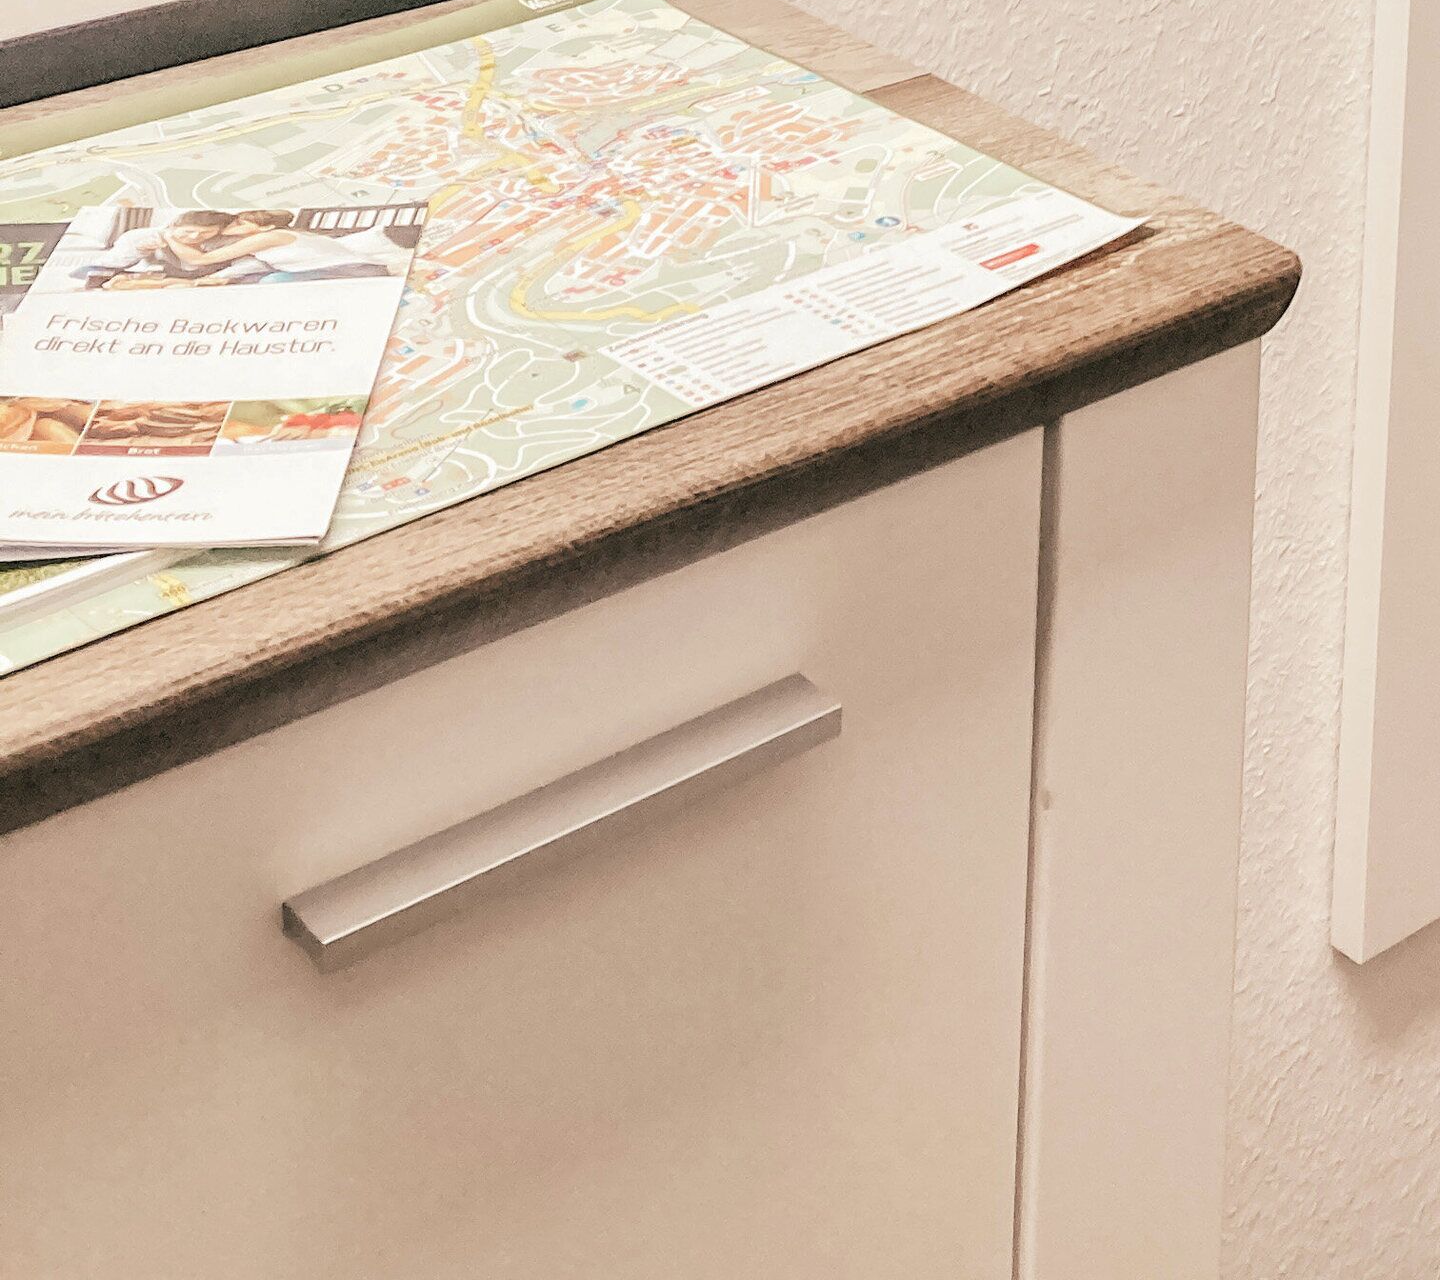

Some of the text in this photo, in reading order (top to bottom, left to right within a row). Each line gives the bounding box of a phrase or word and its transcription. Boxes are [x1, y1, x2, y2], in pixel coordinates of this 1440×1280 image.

[46, 314, 337, 335] Frische Backwaren
[34, 336, 120, 354] direkt
[128, 342, 163, 356] an
[172, 340, 212, 357] die
[128, 447, 160, 455] Brot
